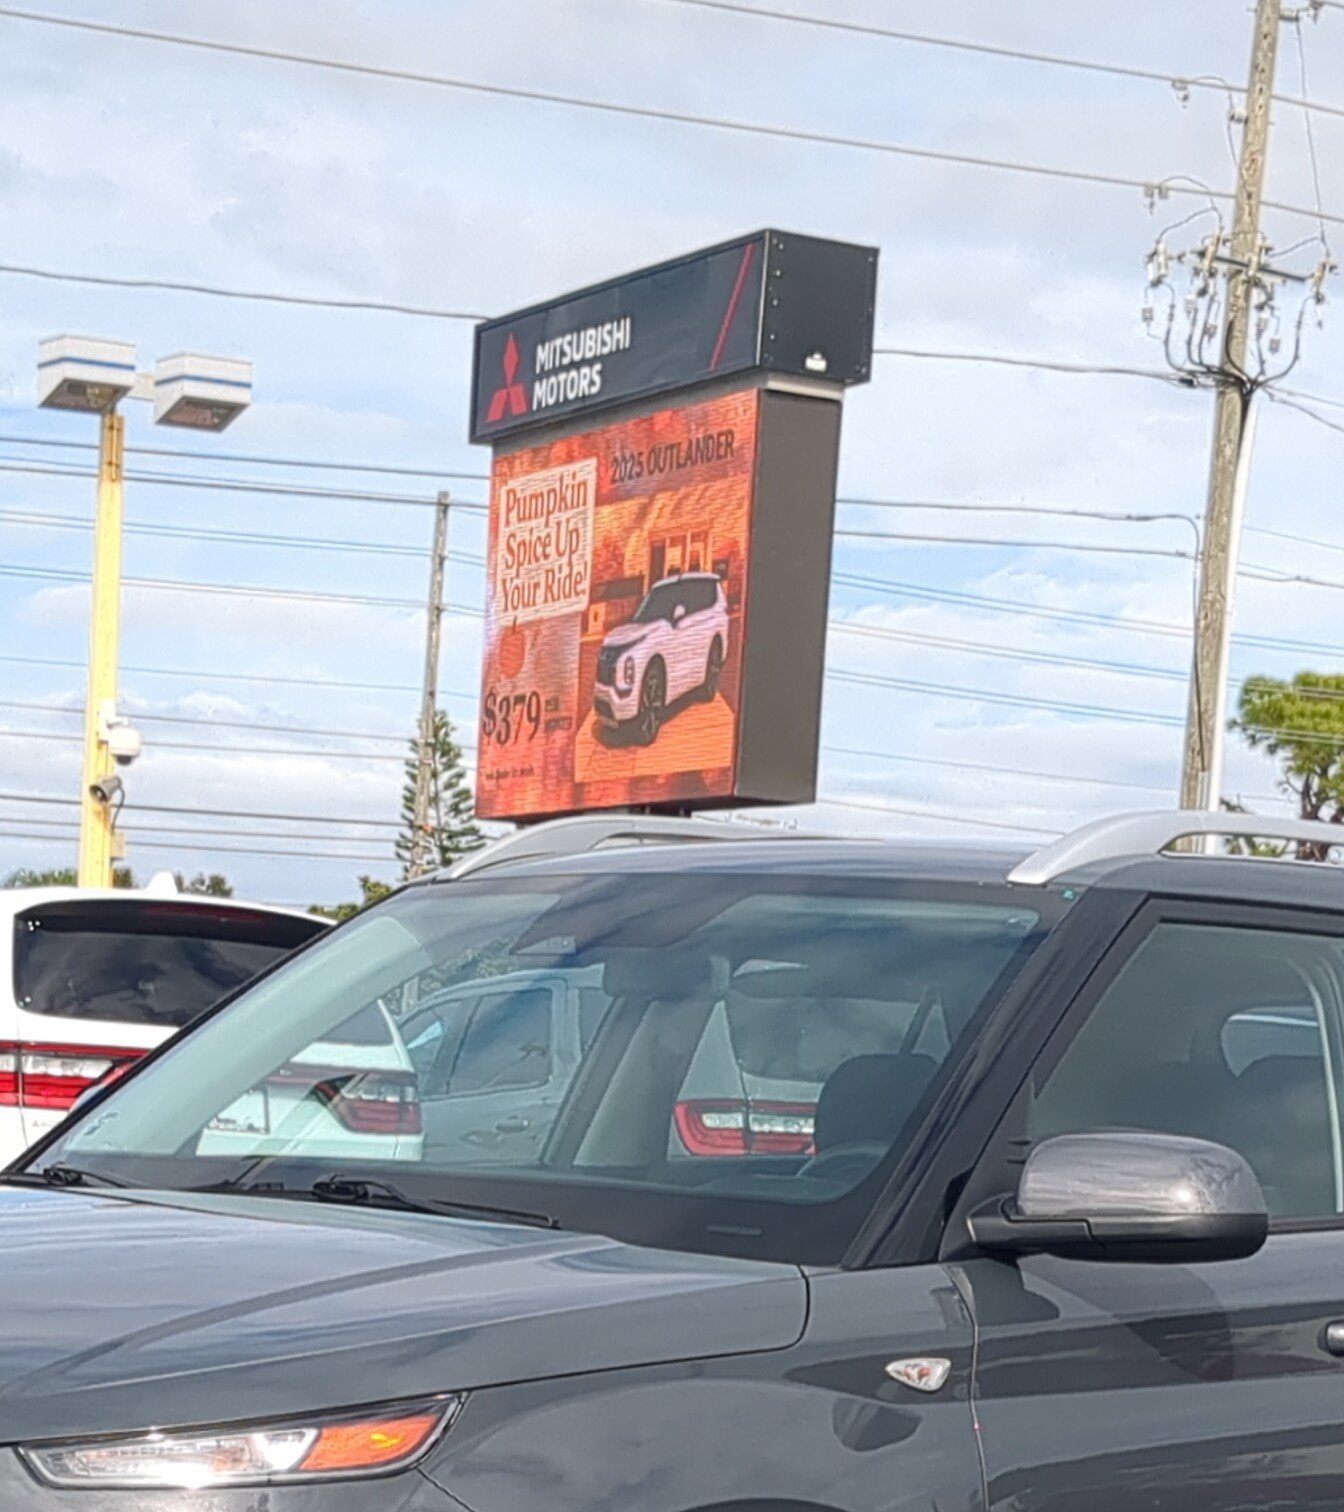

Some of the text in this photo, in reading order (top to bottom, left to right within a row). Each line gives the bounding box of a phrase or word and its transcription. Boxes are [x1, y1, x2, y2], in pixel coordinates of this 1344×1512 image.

[536, 316, 631, 375] MITSUBISHI
[532, 362, 602, 411] MOTORS
[611, 428, 735, 485] 2025 OUTLANDER
[504, 471, 588, 527] Pumpkin
[504, 517, 580, 578] Spice Up
[501, 560, 588, 613] Your Ride!
[482, 688, 541, 746] $379
